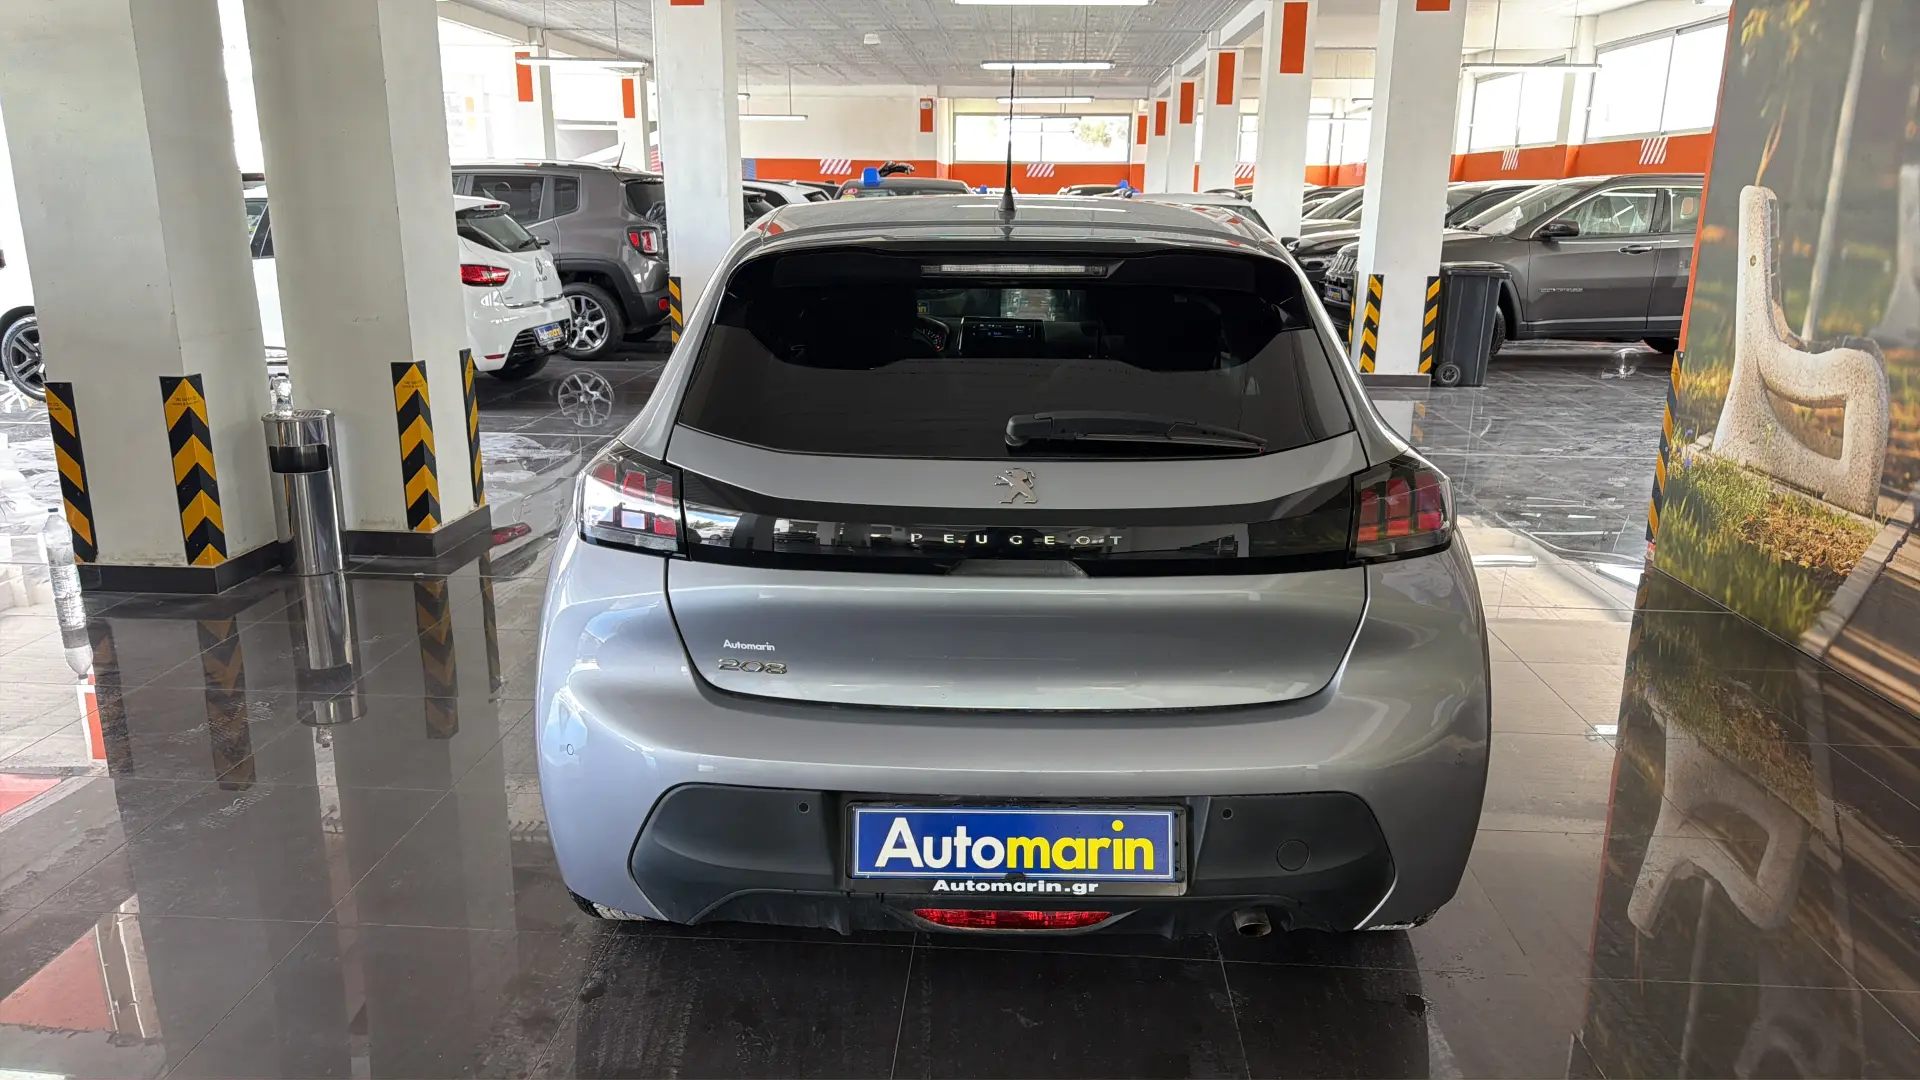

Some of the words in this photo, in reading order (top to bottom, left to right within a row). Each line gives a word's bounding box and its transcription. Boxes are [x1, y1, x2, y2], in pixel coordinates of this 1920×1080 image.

[910, 533, 1122, 545] PEUGEOT
[723, 639, 775, 651] Automarin
[718, 658, 788, 675] 208
[874, 817, 1154, 870] Automarin
[932, 879, 1099, 895] Automarin.gr
